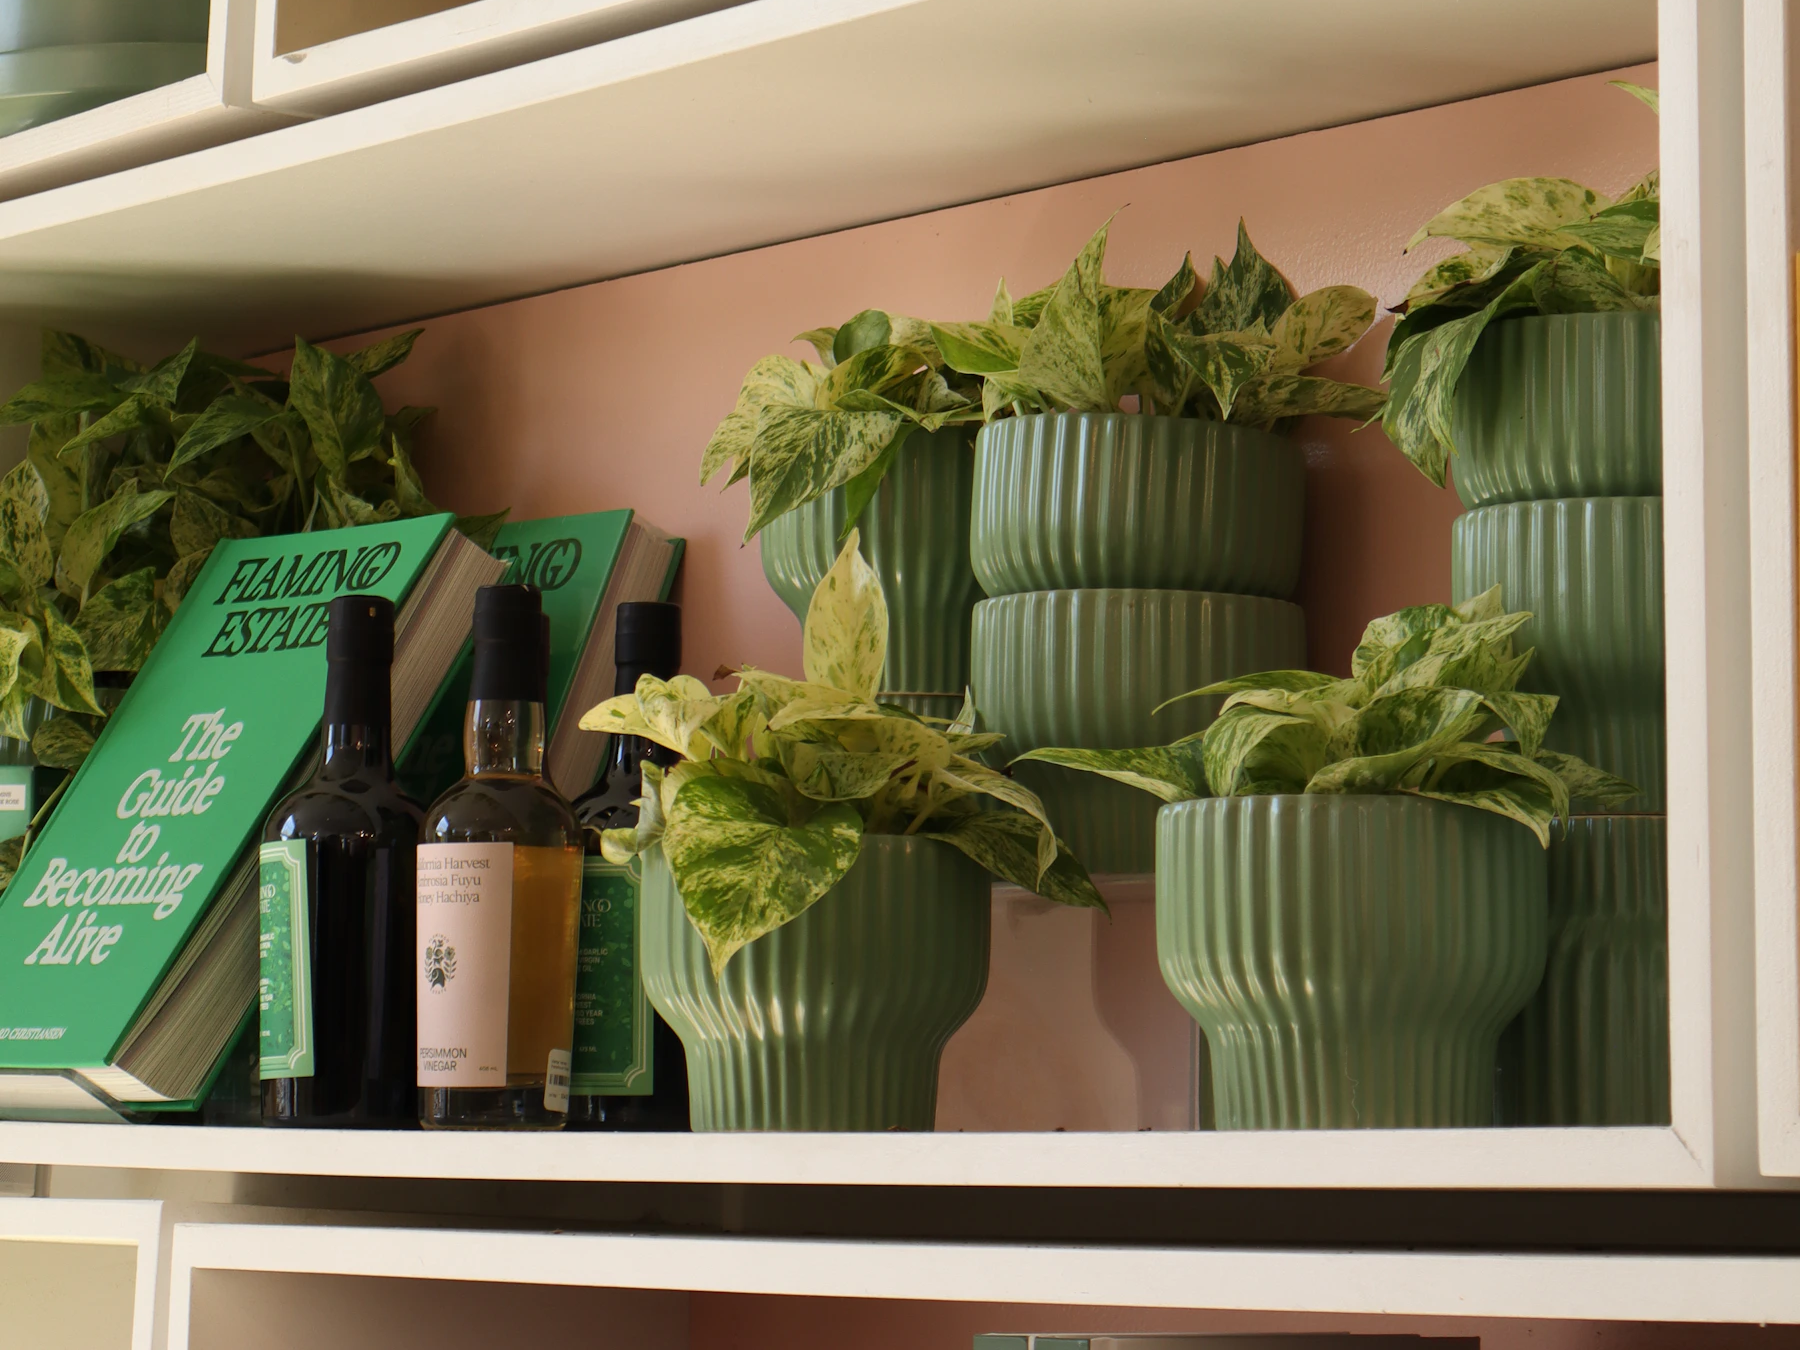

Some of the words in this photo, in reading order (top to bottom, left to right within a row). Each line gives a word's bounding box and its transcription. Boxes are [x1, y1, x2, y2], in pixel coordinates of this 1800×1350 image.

[213, 541, 402, 605] FLAMINGO
[168, 708, 243, 762] The
[117, 762, 225, 819] Guide
[116, 820, 160, 864] to
[444, 856, 491, 870] Harvest
[23, 852, 203, 920] Becoming
[436, 890, 480, 906] Hachiya
[450, 873, 482, 889] Fuyu
[24, 909, 122, 965] Alive
[420, 1047, 467, 1059] PERSIMMON
[424, 1060, 458, 1072] VINEGAR
